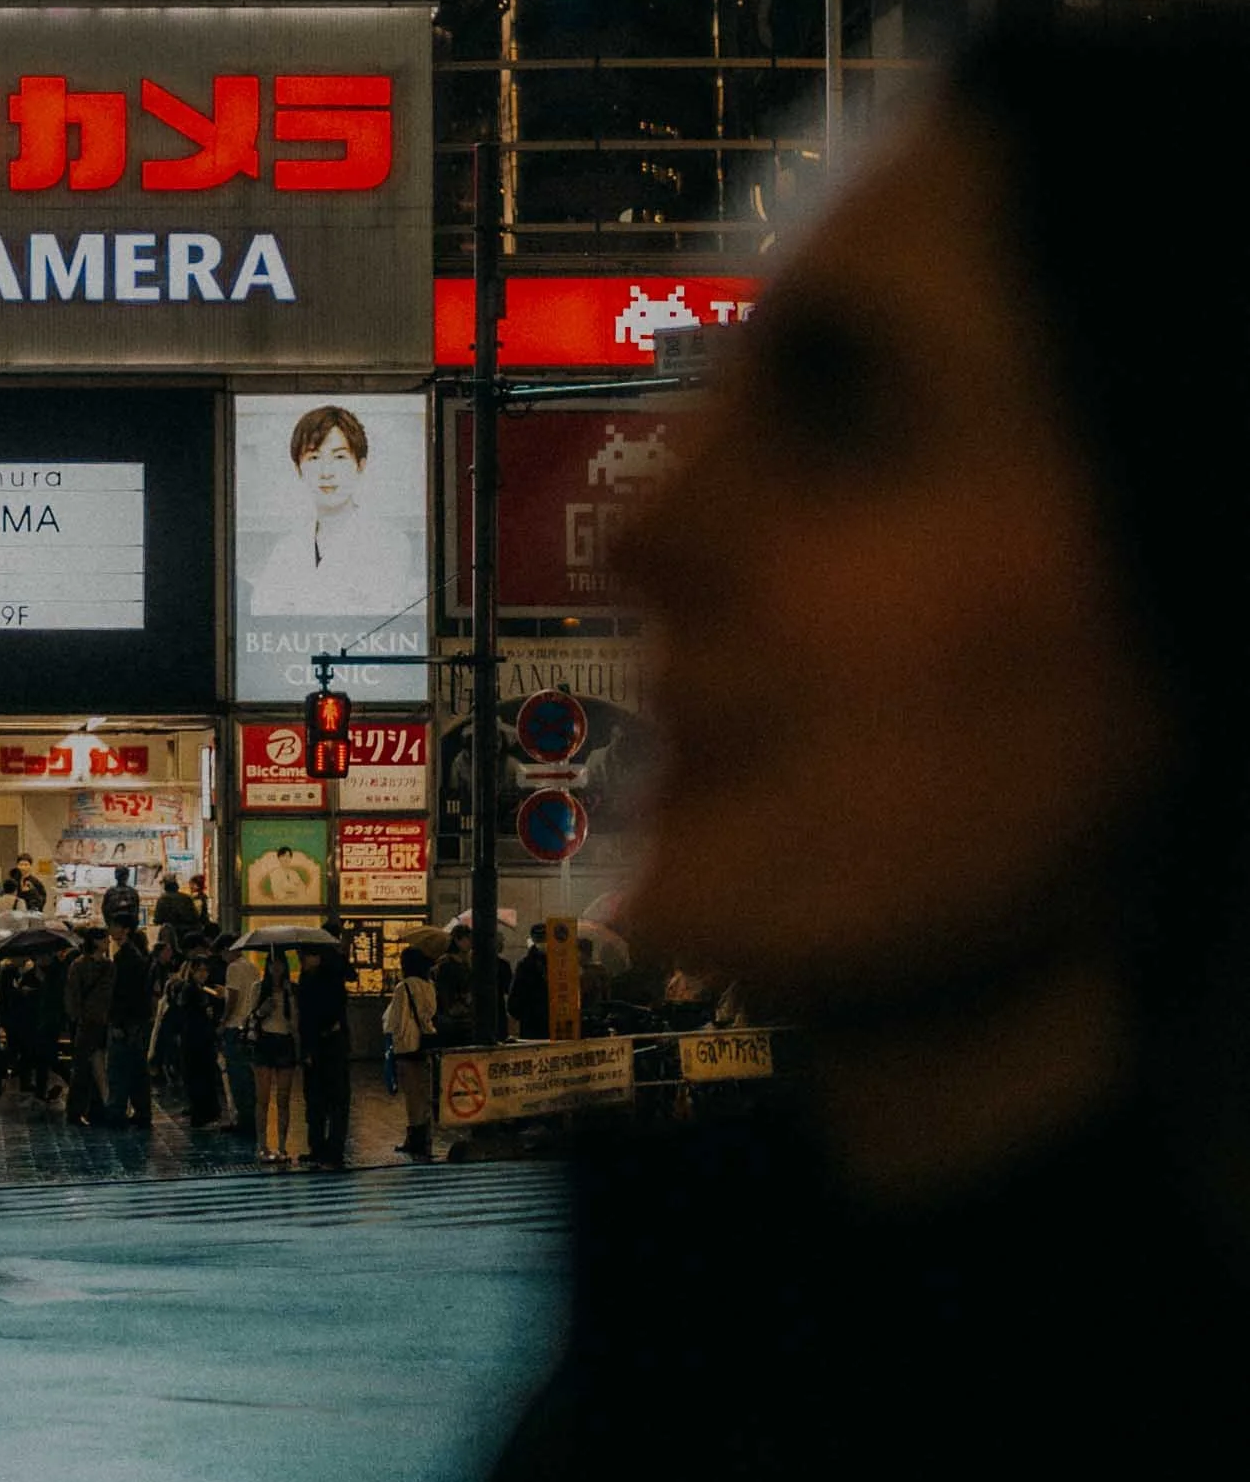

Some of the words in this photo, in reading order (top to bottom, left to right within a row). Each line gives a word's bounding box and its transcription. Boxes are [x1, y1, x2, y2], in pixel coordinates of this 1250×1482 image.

[0, 606, 30, 627] 9F
[245, 632, 353, 655] BEAUTY
[357, 632, 419, 654] SKIN
[284, 663, 382, 687] CLNIC
[391, 851, 421, 869] OK
